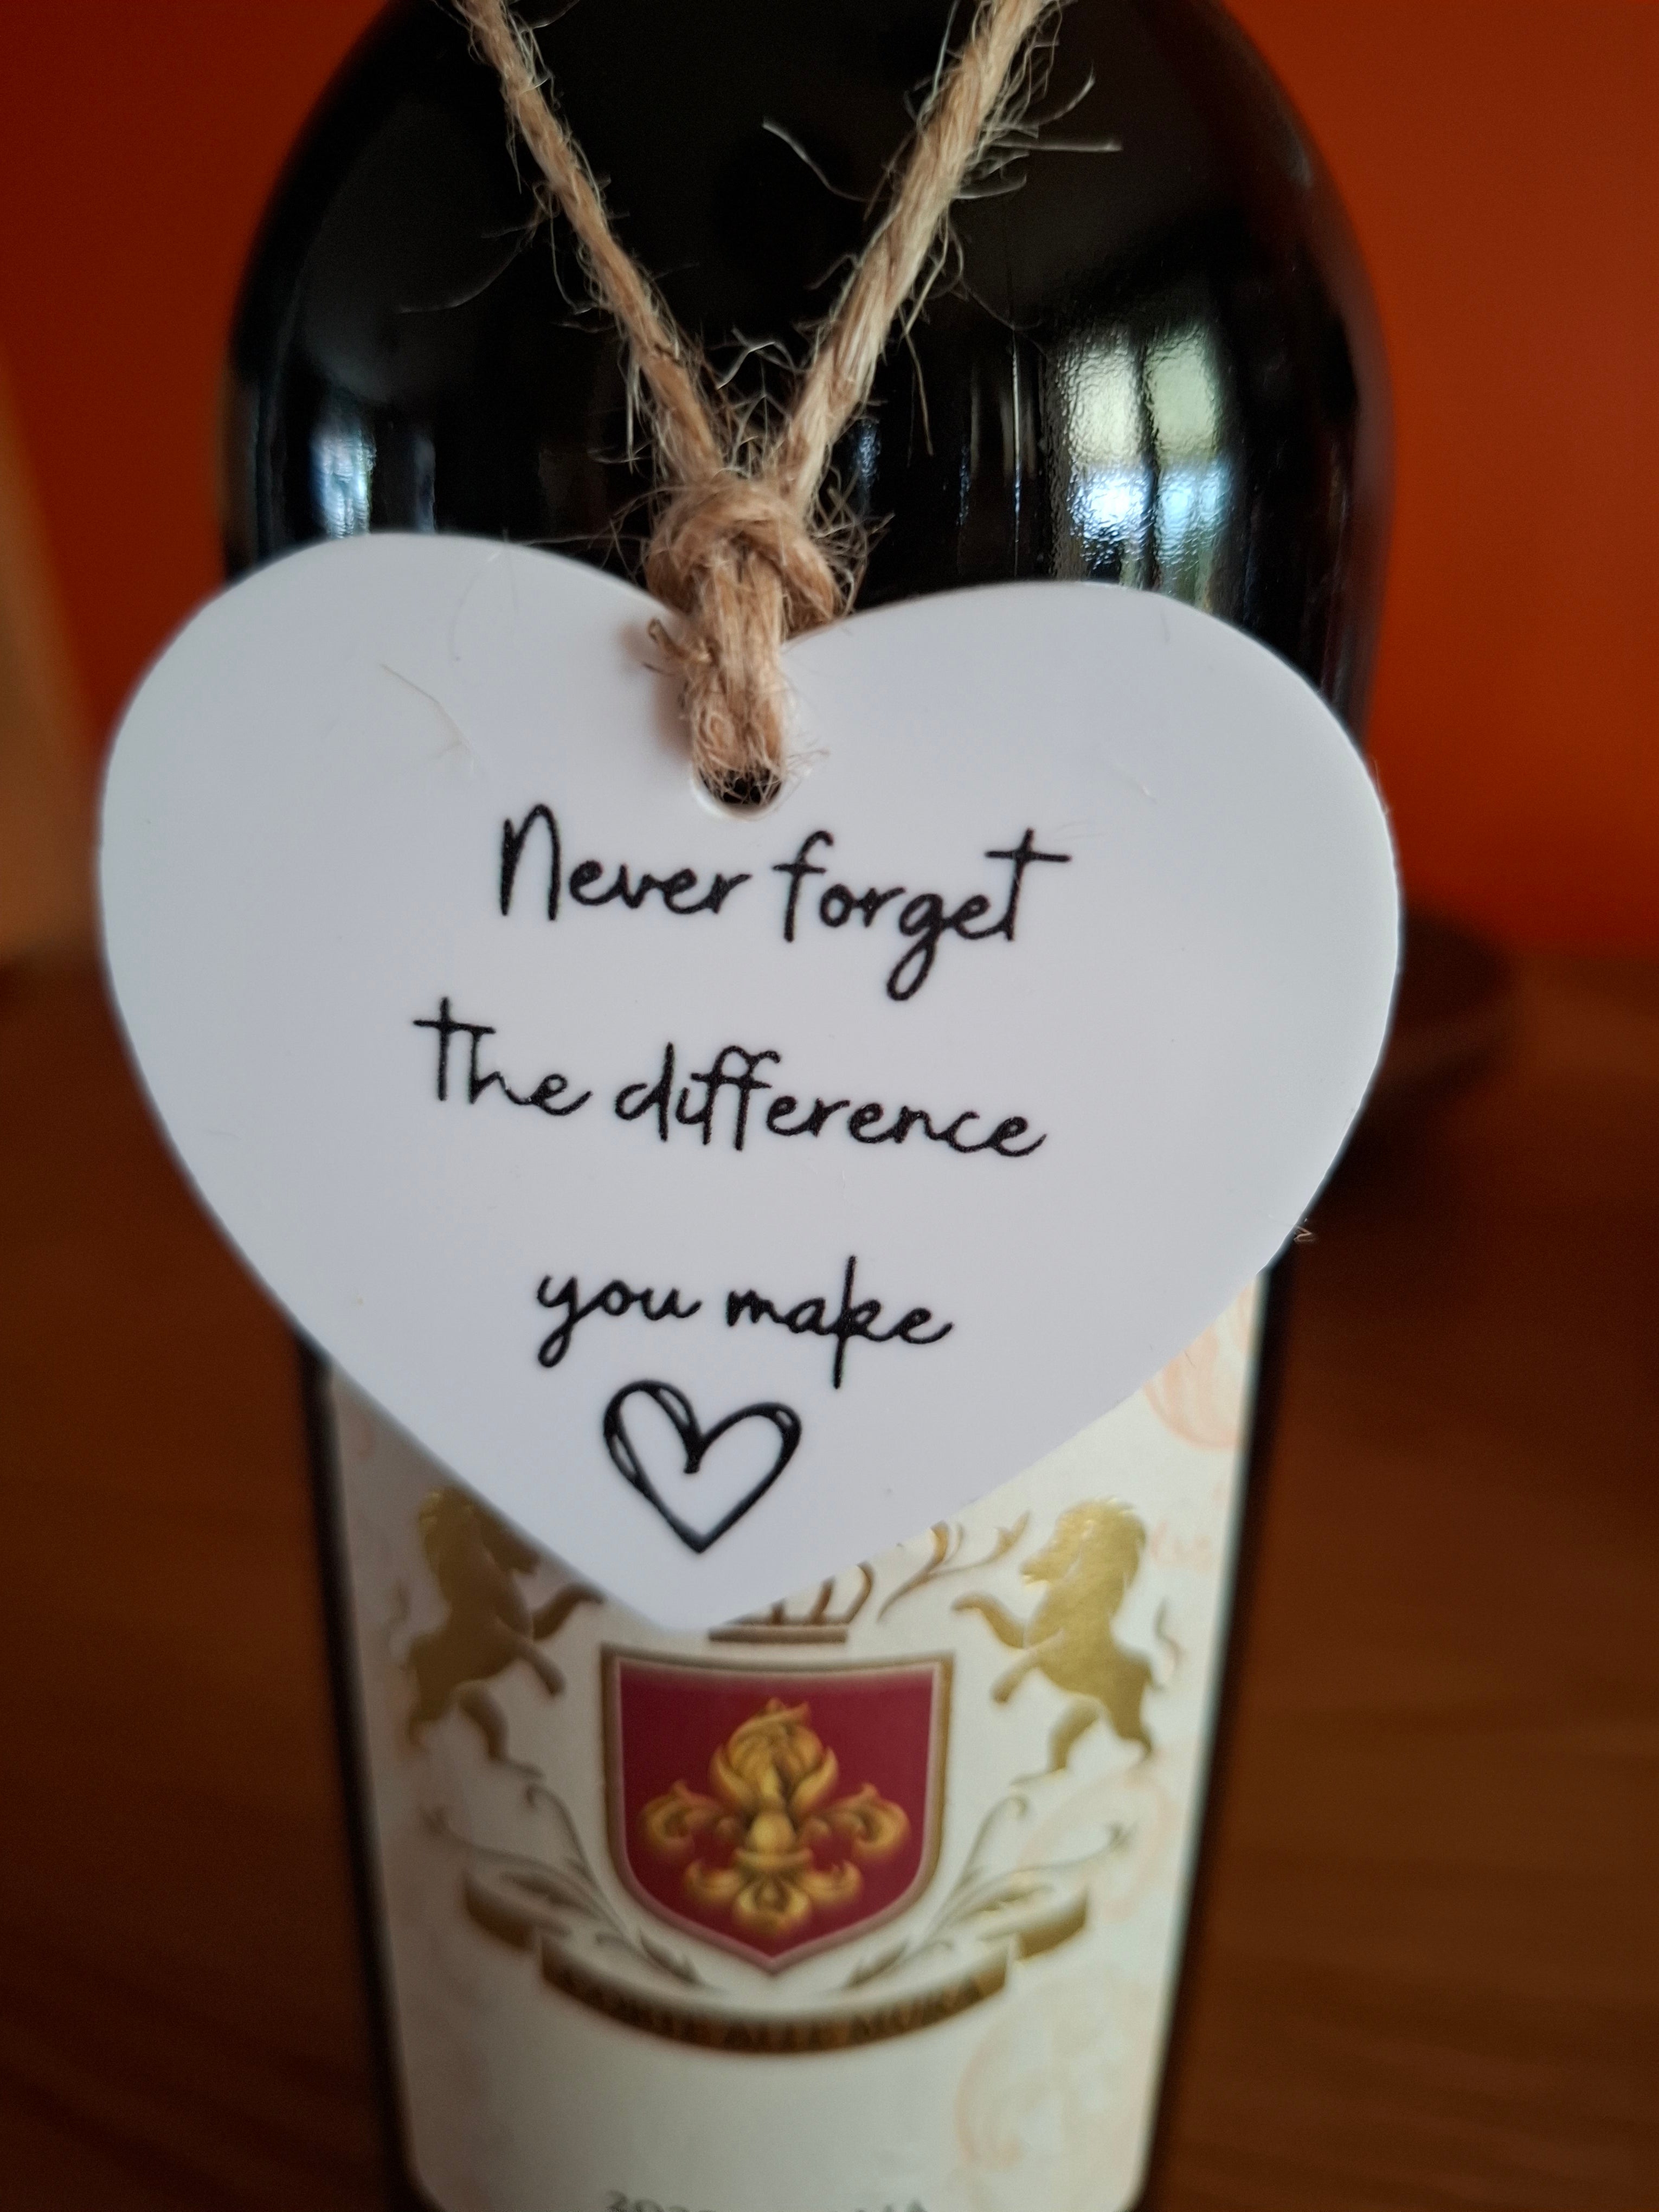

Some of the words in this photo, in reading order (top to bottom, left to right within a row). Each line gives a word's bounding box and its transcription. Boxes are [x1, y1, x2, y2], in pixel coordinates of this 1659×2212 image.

[498, 802, 752, 922] Never
[771, 827, 1072, 1003] forget
[412, 996, 594, 1117] the
[613, 1041, 1047, 1159] difference
[535, 1275, 703, 1369] you
[724, 1255, 954, 1391] make
